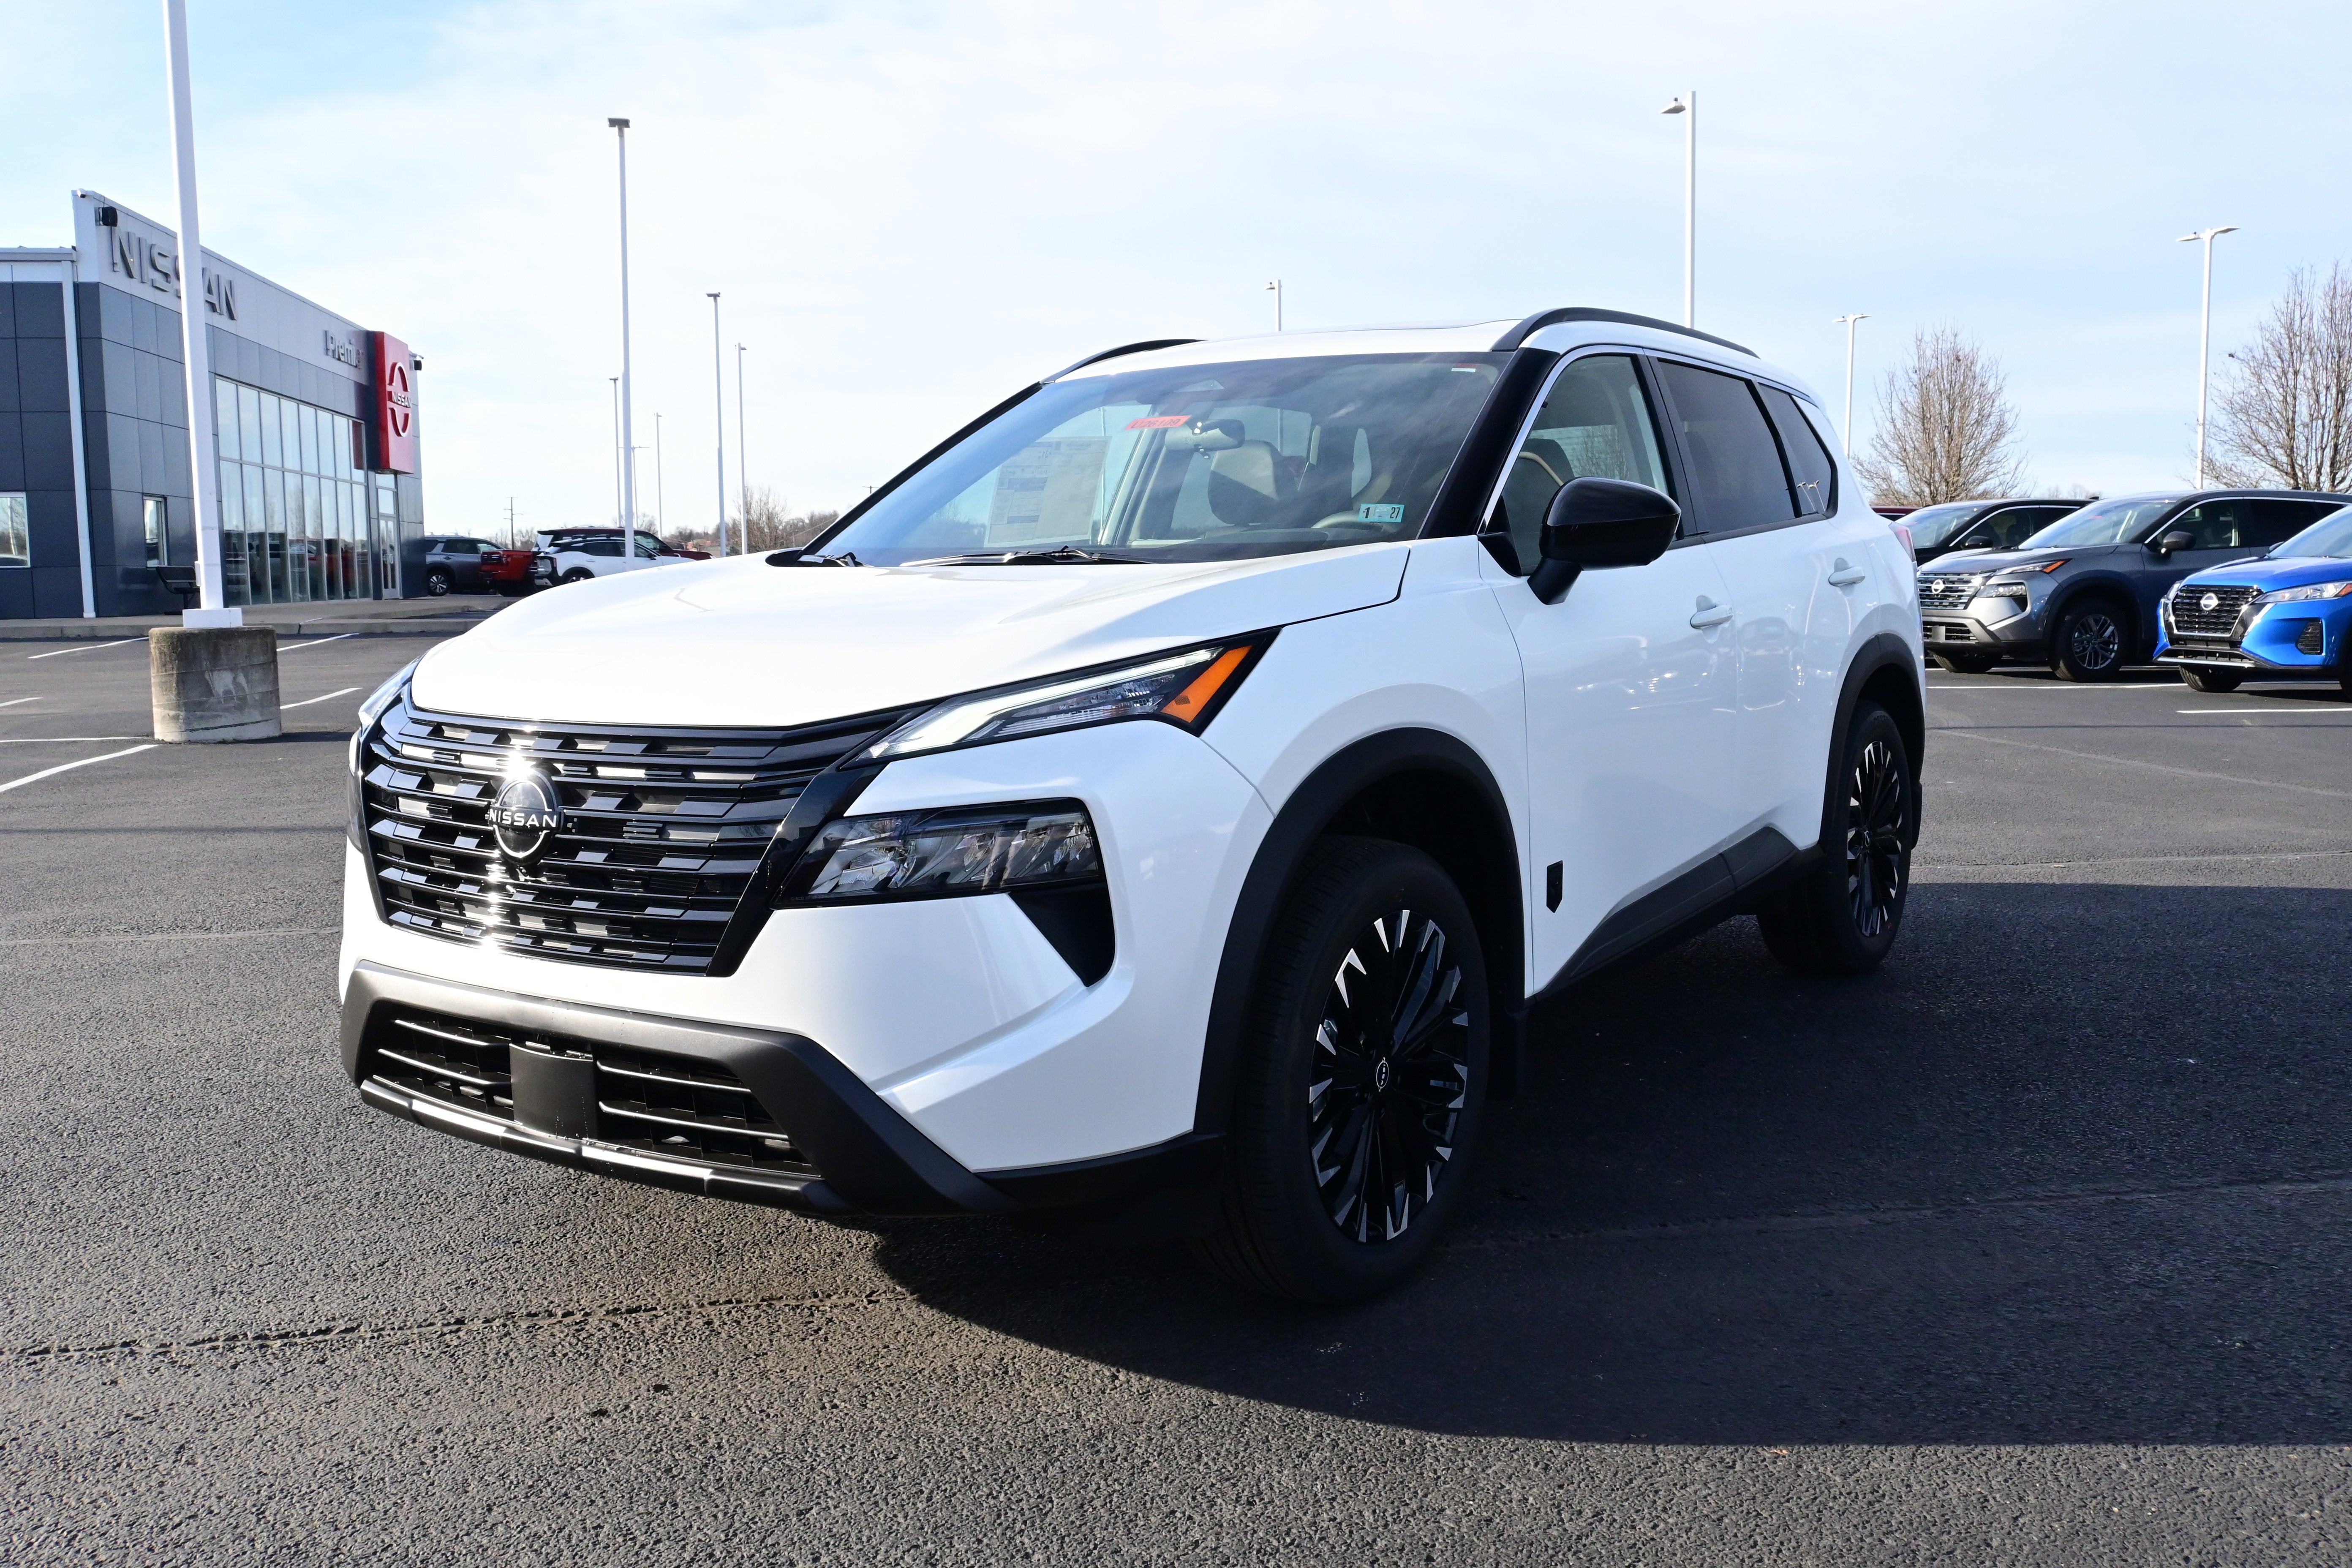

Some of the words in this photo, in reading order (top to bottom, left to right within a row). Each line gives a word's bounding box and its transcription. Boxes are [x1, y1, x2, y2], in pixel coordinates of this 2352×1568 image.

[392, 390, 411, 408] NISSAN
[1390, 506, 1401, 520] 27
[489, 808, 557, 828] NISSAN
